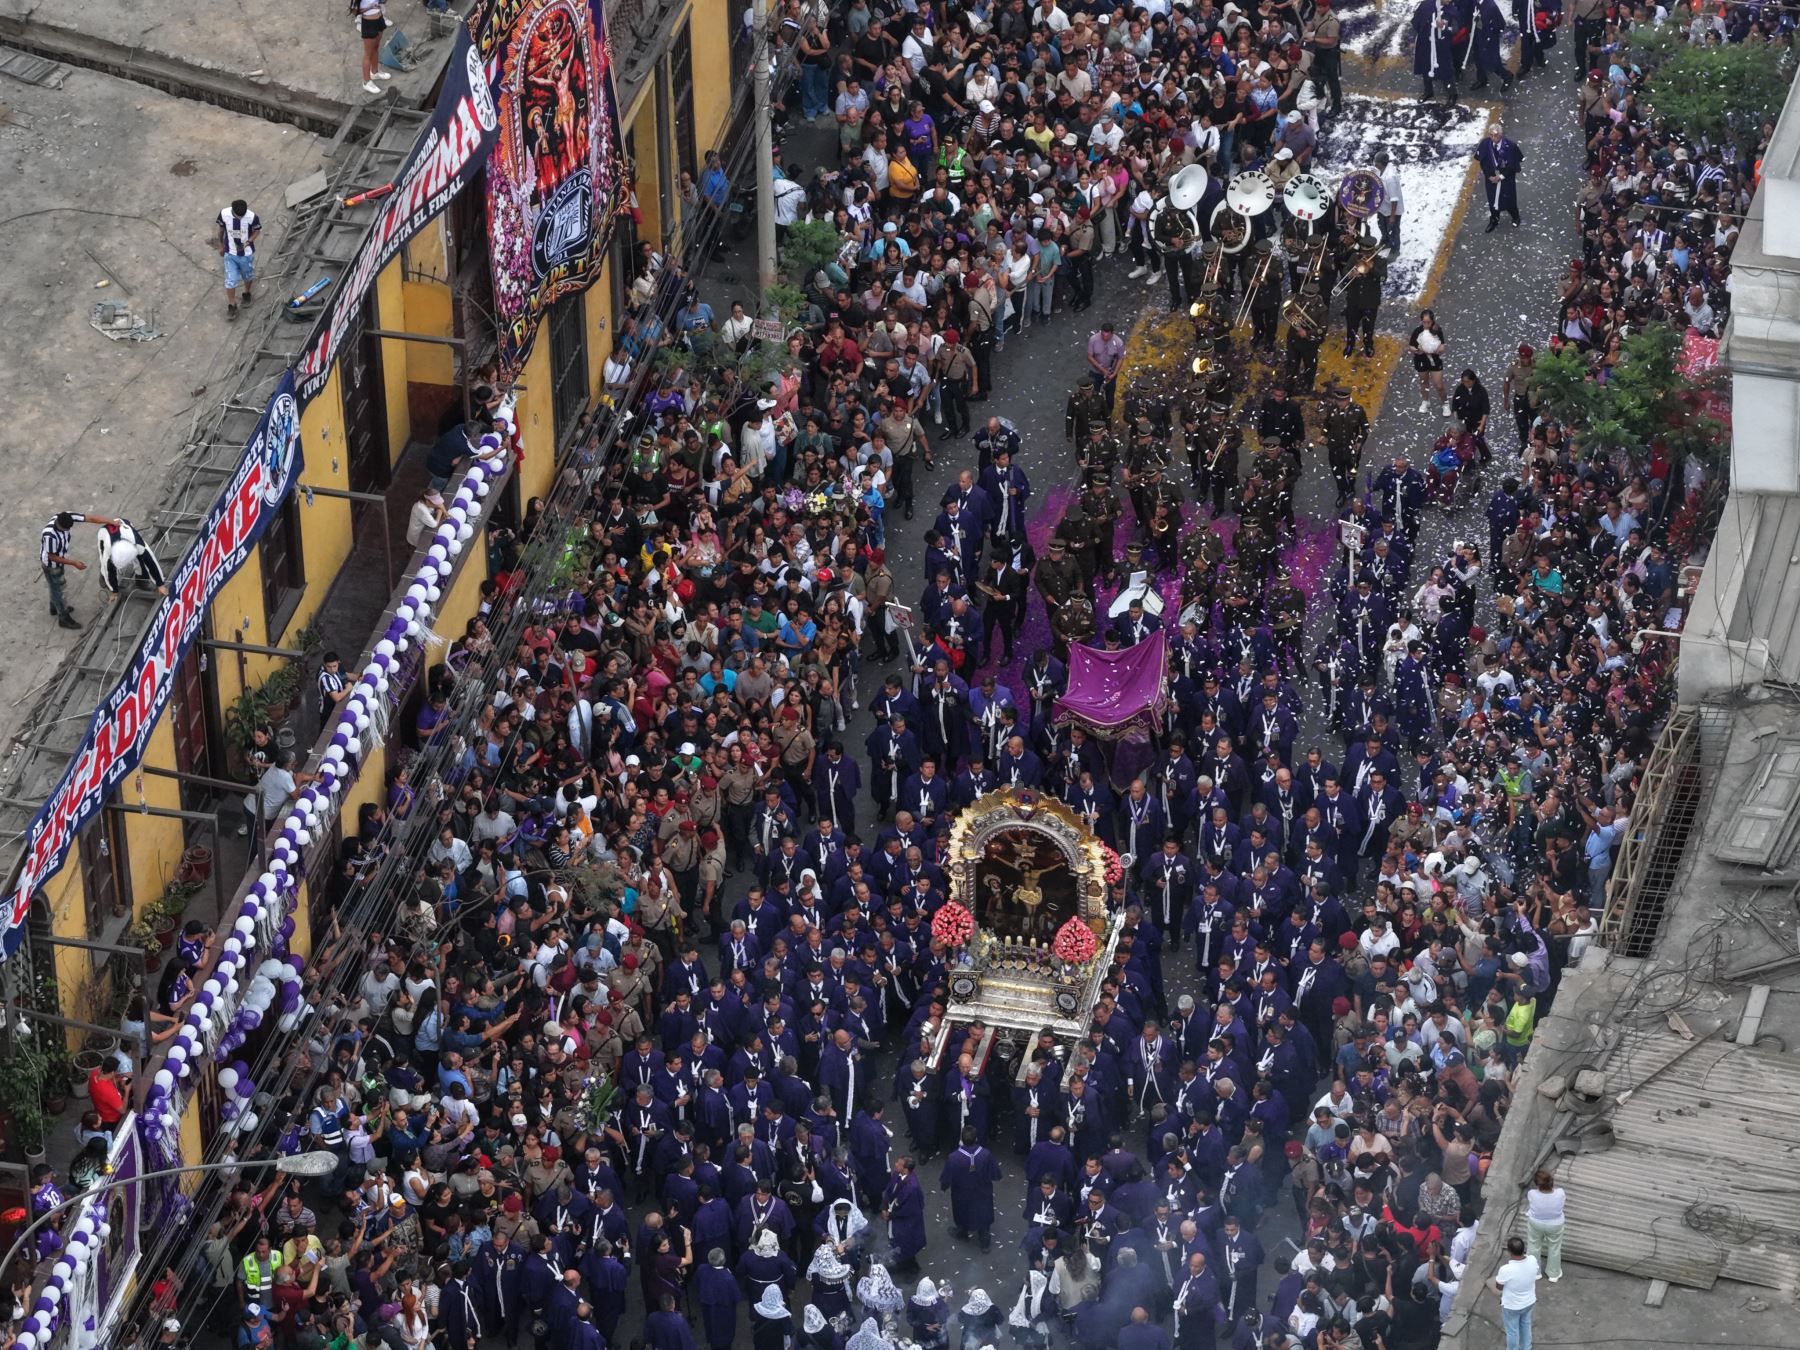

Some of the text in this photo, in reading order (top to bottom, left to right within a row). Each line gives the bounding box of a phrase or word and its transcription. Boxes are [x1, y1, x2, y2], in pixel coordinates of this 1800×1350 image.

[1229, 172, 1274, 200] EJERCITO
[1284, 175, 1328, 211] EJERCITO
[381, 219, 413, 264] HASTA
[413, 207, 428, 229] EL
[428, 175, 464, 216] FINAL
[163, 454, 261, 674] GRONE
[109, 679, 127, 711] VOY
[132, 665, 139, 685] A
[142, 596, 171, 662] ESTAR
[174, 539, 204, 595] HASTA
[208, 508, 220, 536] LA
[109, 757, 127, 785] LA
